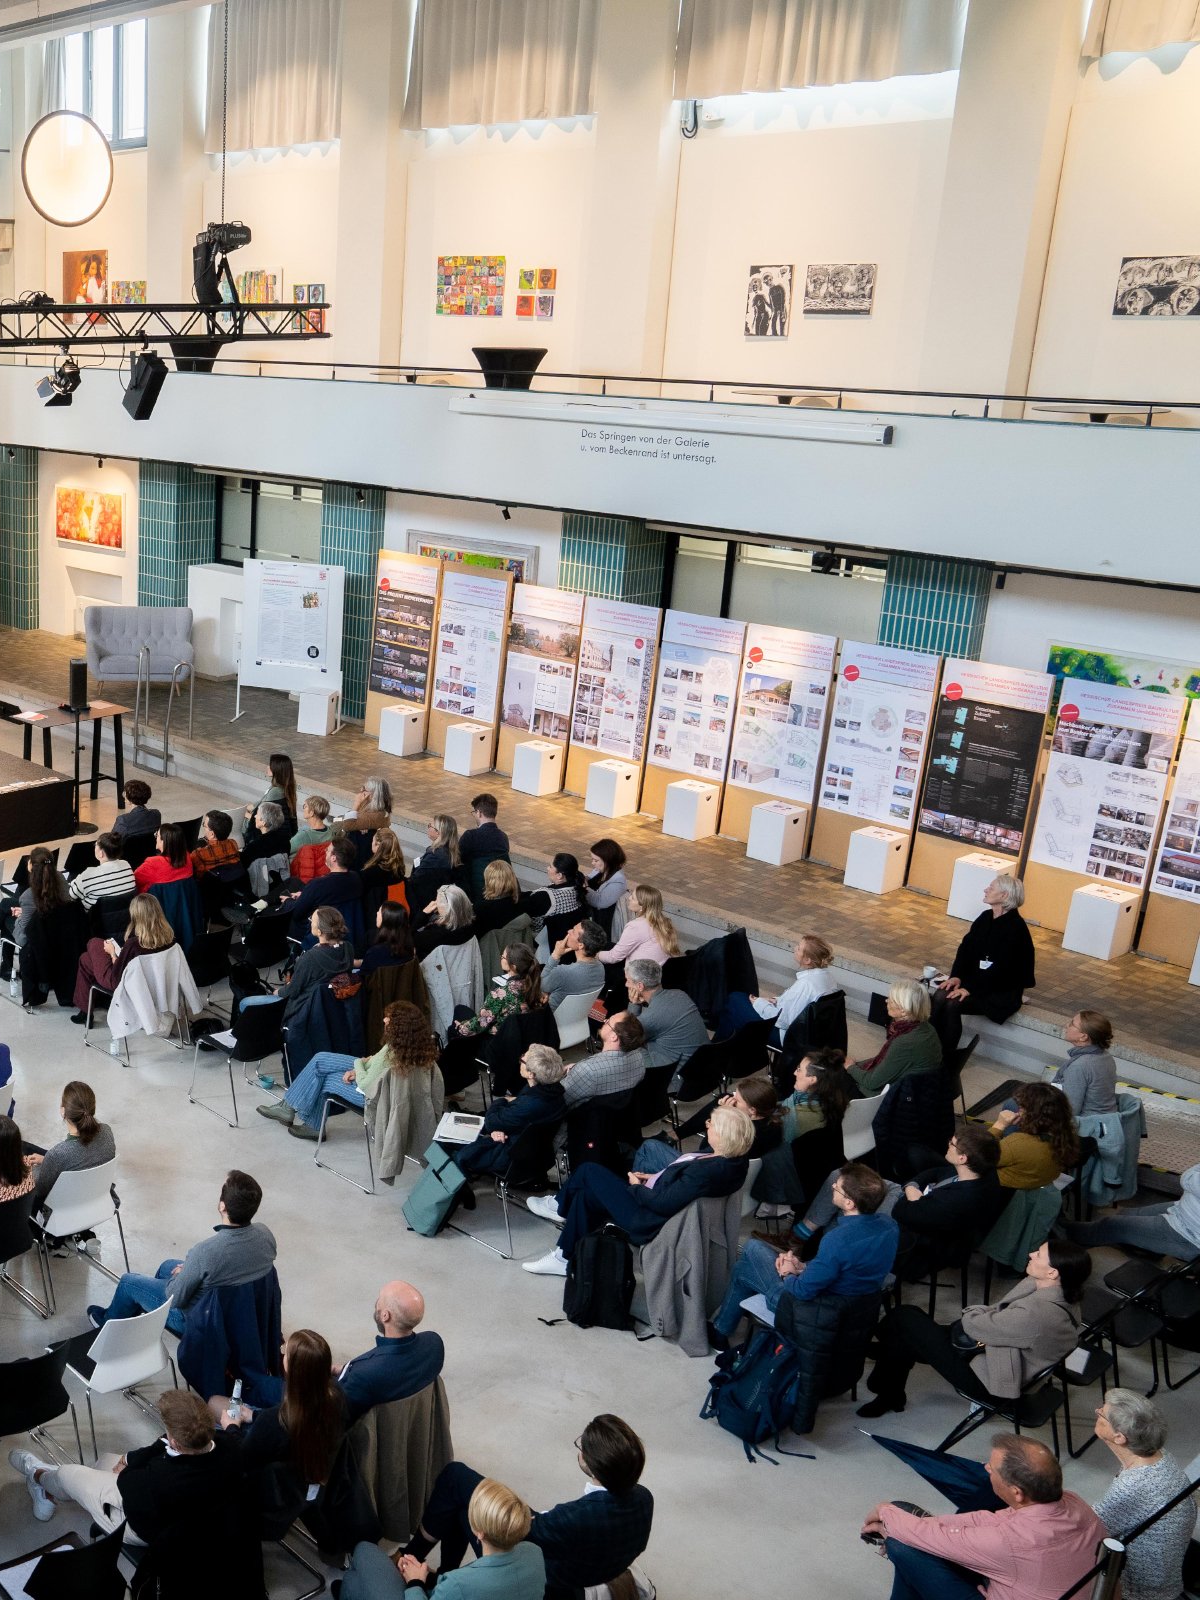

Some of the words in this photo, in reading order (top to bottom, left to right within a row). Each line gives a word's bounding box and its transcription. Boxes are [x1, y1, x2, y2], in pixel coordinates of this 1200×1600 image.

[581, 429, 597, 439] Das
[599, 430, 636, 443] Springen
[639, 436, 654, 444] von
[656, 435, 672, 445] der
[674, 436, 710, 449] Galerie
[609, 445, 658, 458] Beckenrand
[661, 450, 670, 459] ist
[672, 452, 717, 465] untersagt.
